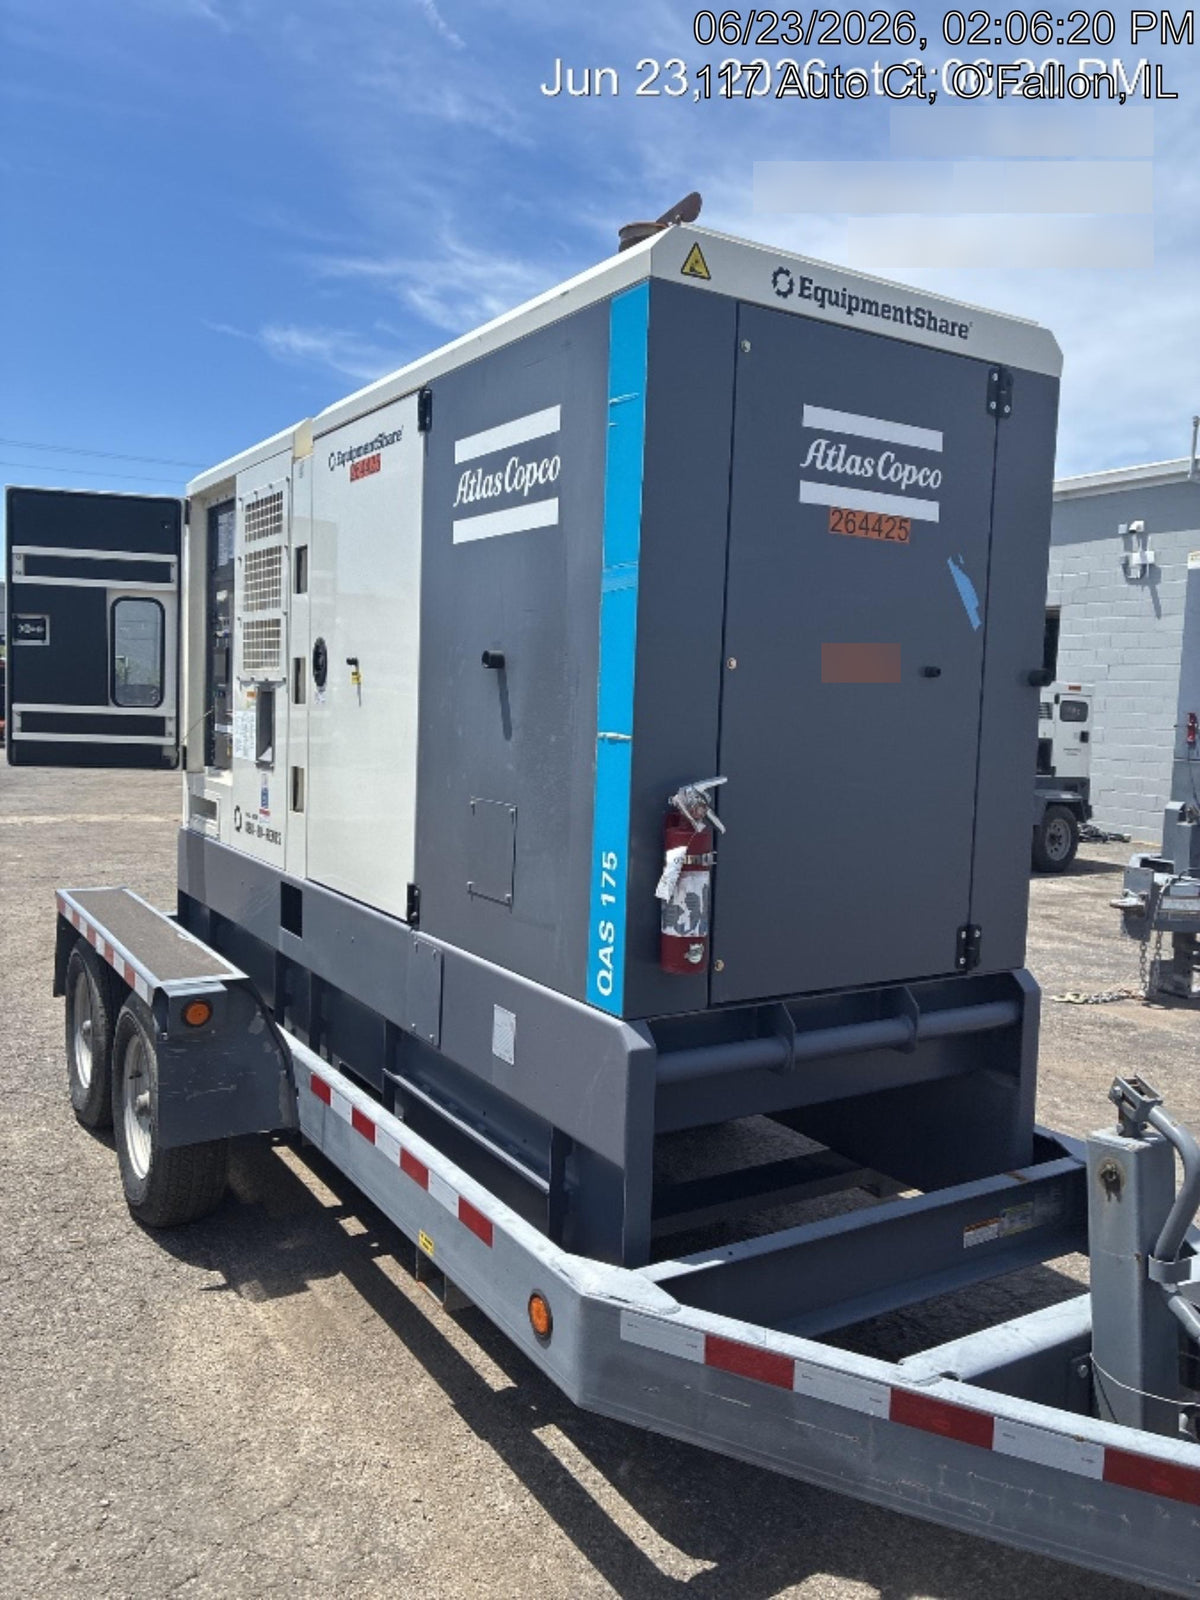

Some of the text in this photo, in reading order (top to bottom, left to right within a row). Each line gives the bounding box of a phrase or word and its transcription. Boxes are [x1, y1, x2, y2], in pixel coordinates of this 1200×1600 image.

[798, 275, 970, 340] EquipmentShare
[453, 454, 561, 508] Atlas Copco
[800, 438, 942, 490] Atlas Copco
[830, 509, 910, 541] 264425
[597, 851, 618, 996] QAS 175
